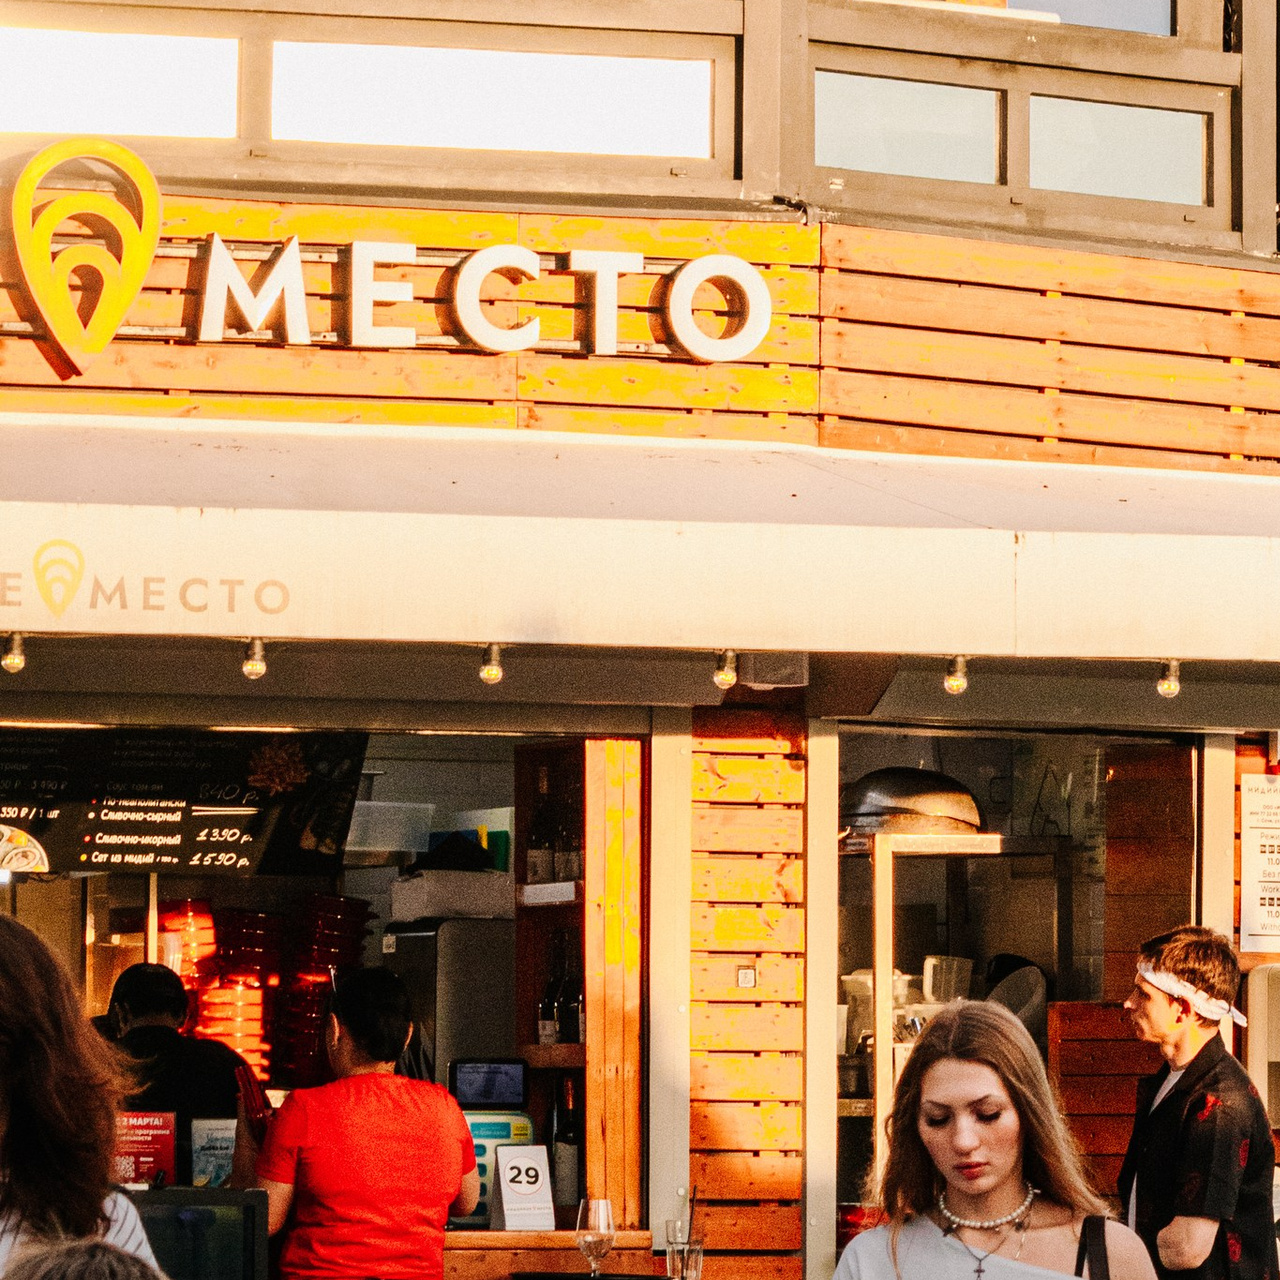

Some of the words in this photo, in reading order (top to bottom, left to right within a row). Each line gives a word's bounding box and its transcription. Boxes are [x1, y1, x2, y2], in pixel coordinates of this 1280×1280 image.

[198, 232, 772, 363] МЕСТО
[88, 575, 291, 616] МЕСТО
[100, 809, 182, 823] Сливочно-сырный
[95, 832, 182, 847] Сливочно-икорный
[91, 851, 109, 862] Сет
[110, 854, 123, 862] из
[124, 853, 155, 864] мидий
[1262, 870, 1275, 878] Без
[129, 1117, 163, 1126] МАРТА!
[509, 1165, 540, 1186] 29
